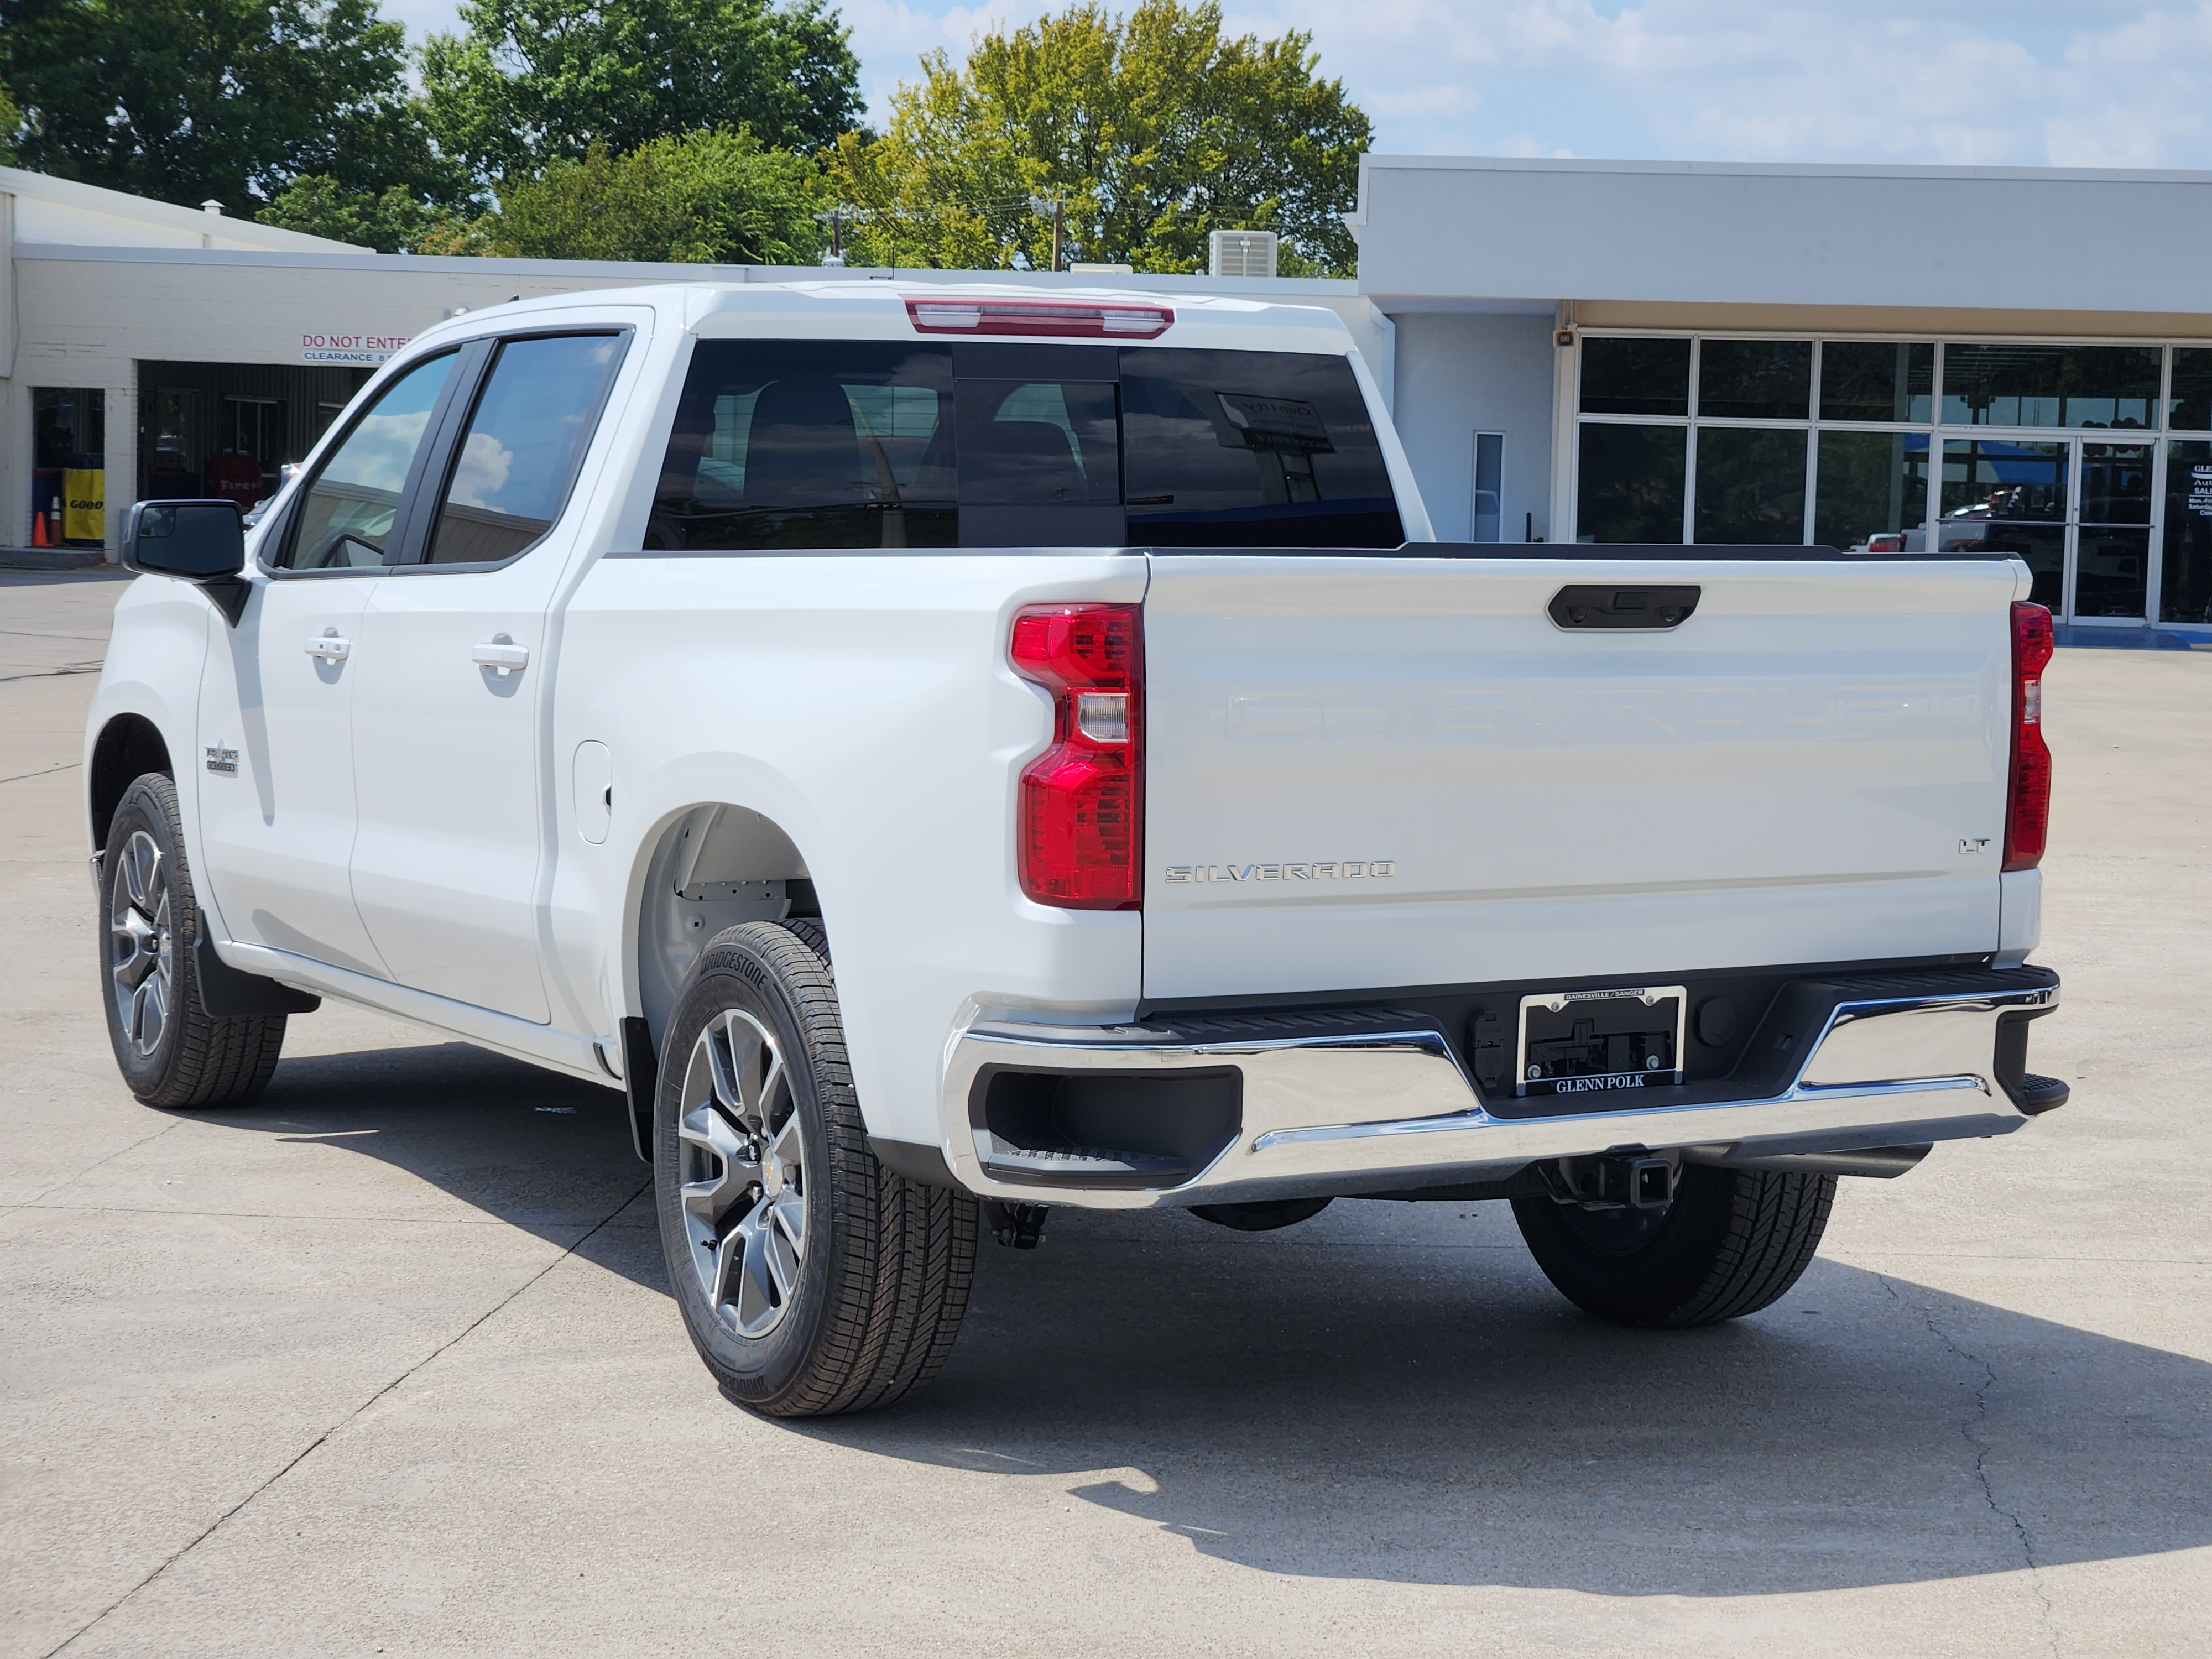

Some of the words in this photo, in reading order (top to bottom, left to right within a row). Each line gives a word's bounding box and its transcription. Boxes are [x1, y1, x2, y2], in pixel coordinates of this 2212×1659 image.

[302, 335, 325, 347] DO
[330, 336, 361, 348] NOT
[305, 352, 373, 361] CLEARANCE
[1225, 684, 1966, 742] CHEVROLET
[1959, 838, 1991, 854] LT
[1165, 860, 1396, 883] SILVERADO
[700, 951, 768, 992] BRIDGESTONE
[1556, 1078, 1605, 1093] GLENN
[1607, 1074, 1645, 1089] POLK
